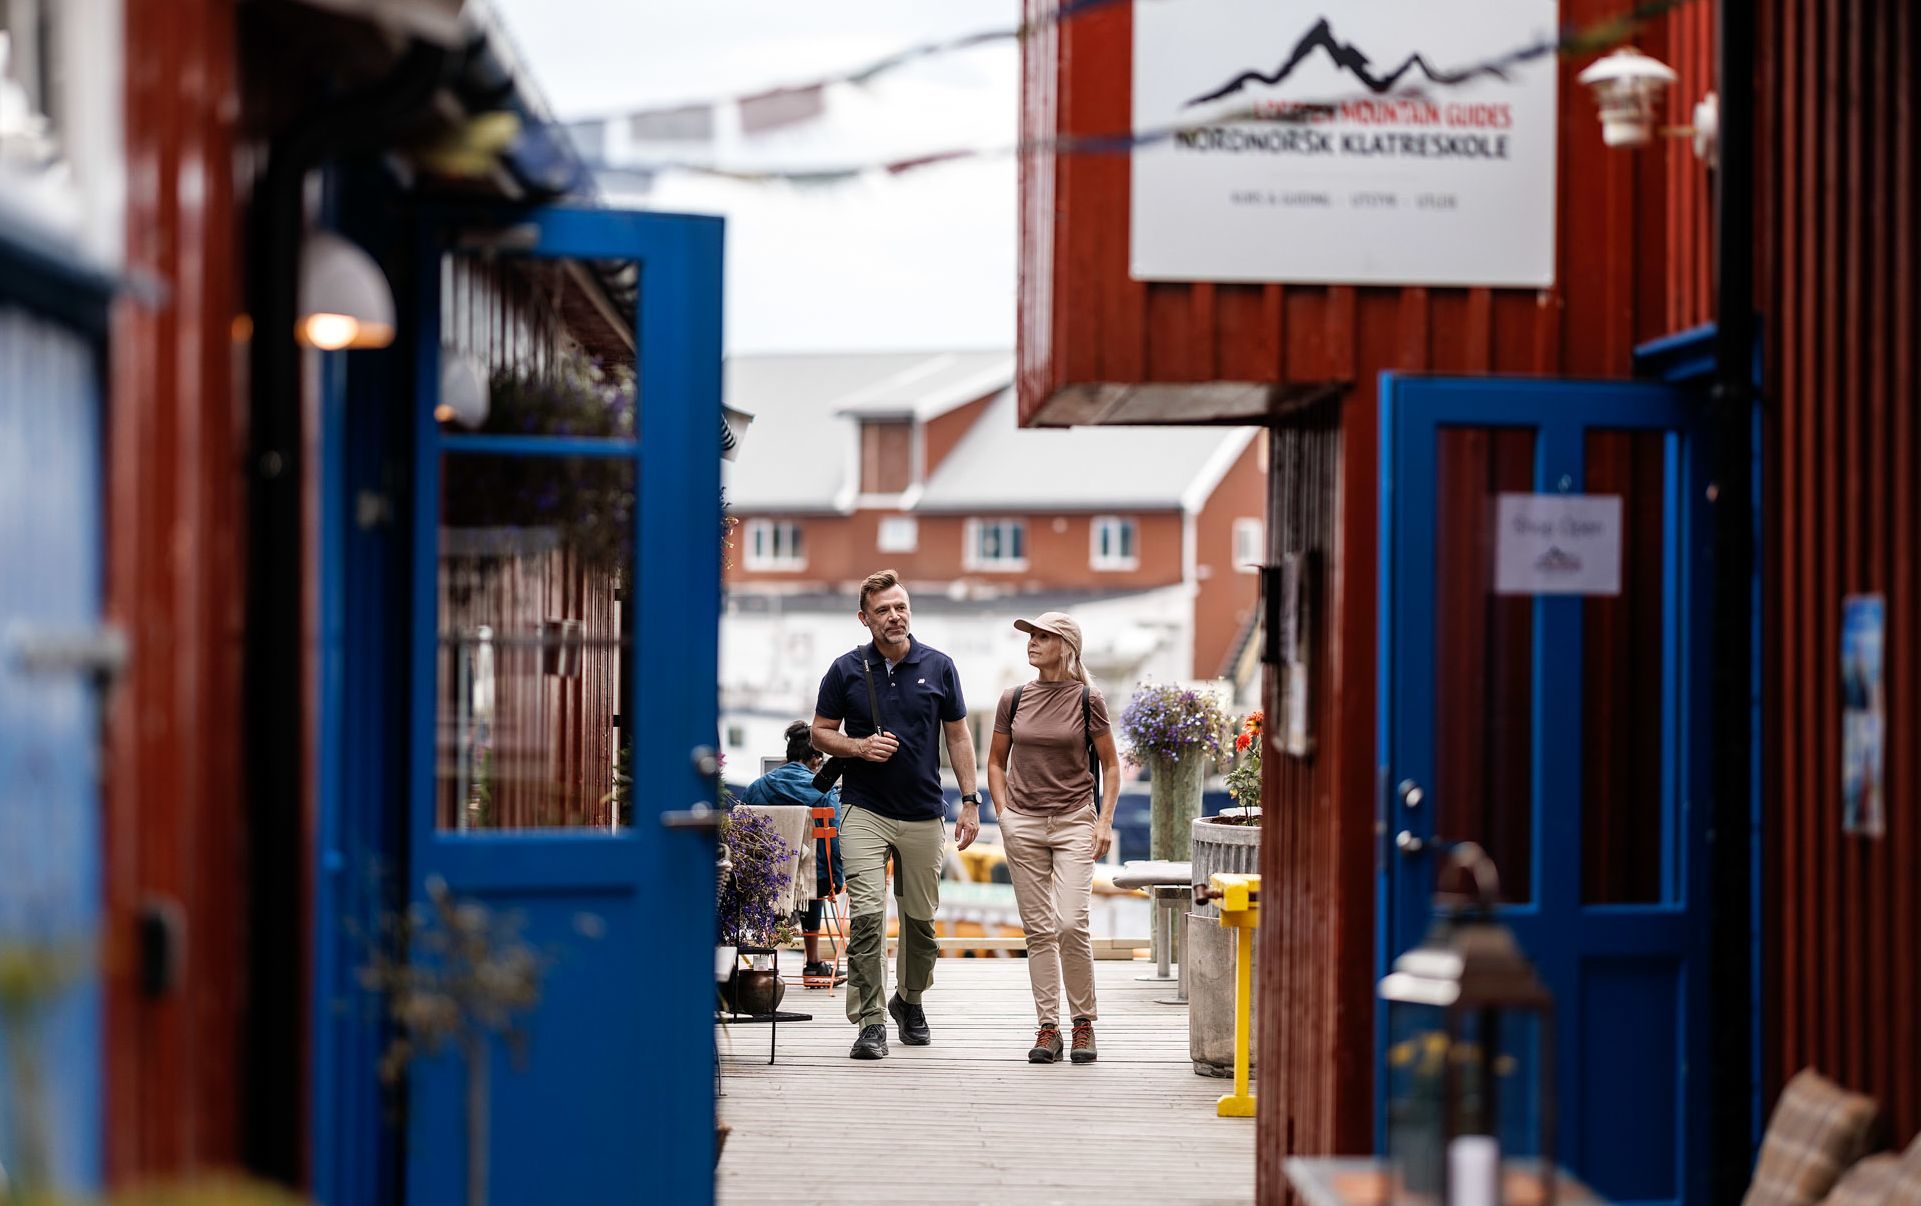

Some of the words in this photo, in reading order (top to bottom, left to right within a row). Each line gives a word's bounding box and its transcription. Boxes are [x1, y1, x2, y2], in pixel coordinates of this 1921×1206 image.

[1253, 100, 1336, 124] LOEN
[1340, 100, 1440, 125] MOUNTAIN
[1446, 104, 1512, 128] GUIDES
[1175, 127, 1333, 154] NORDNORSK
[1341, 132, 1509, 158] KLATRESKOLE
